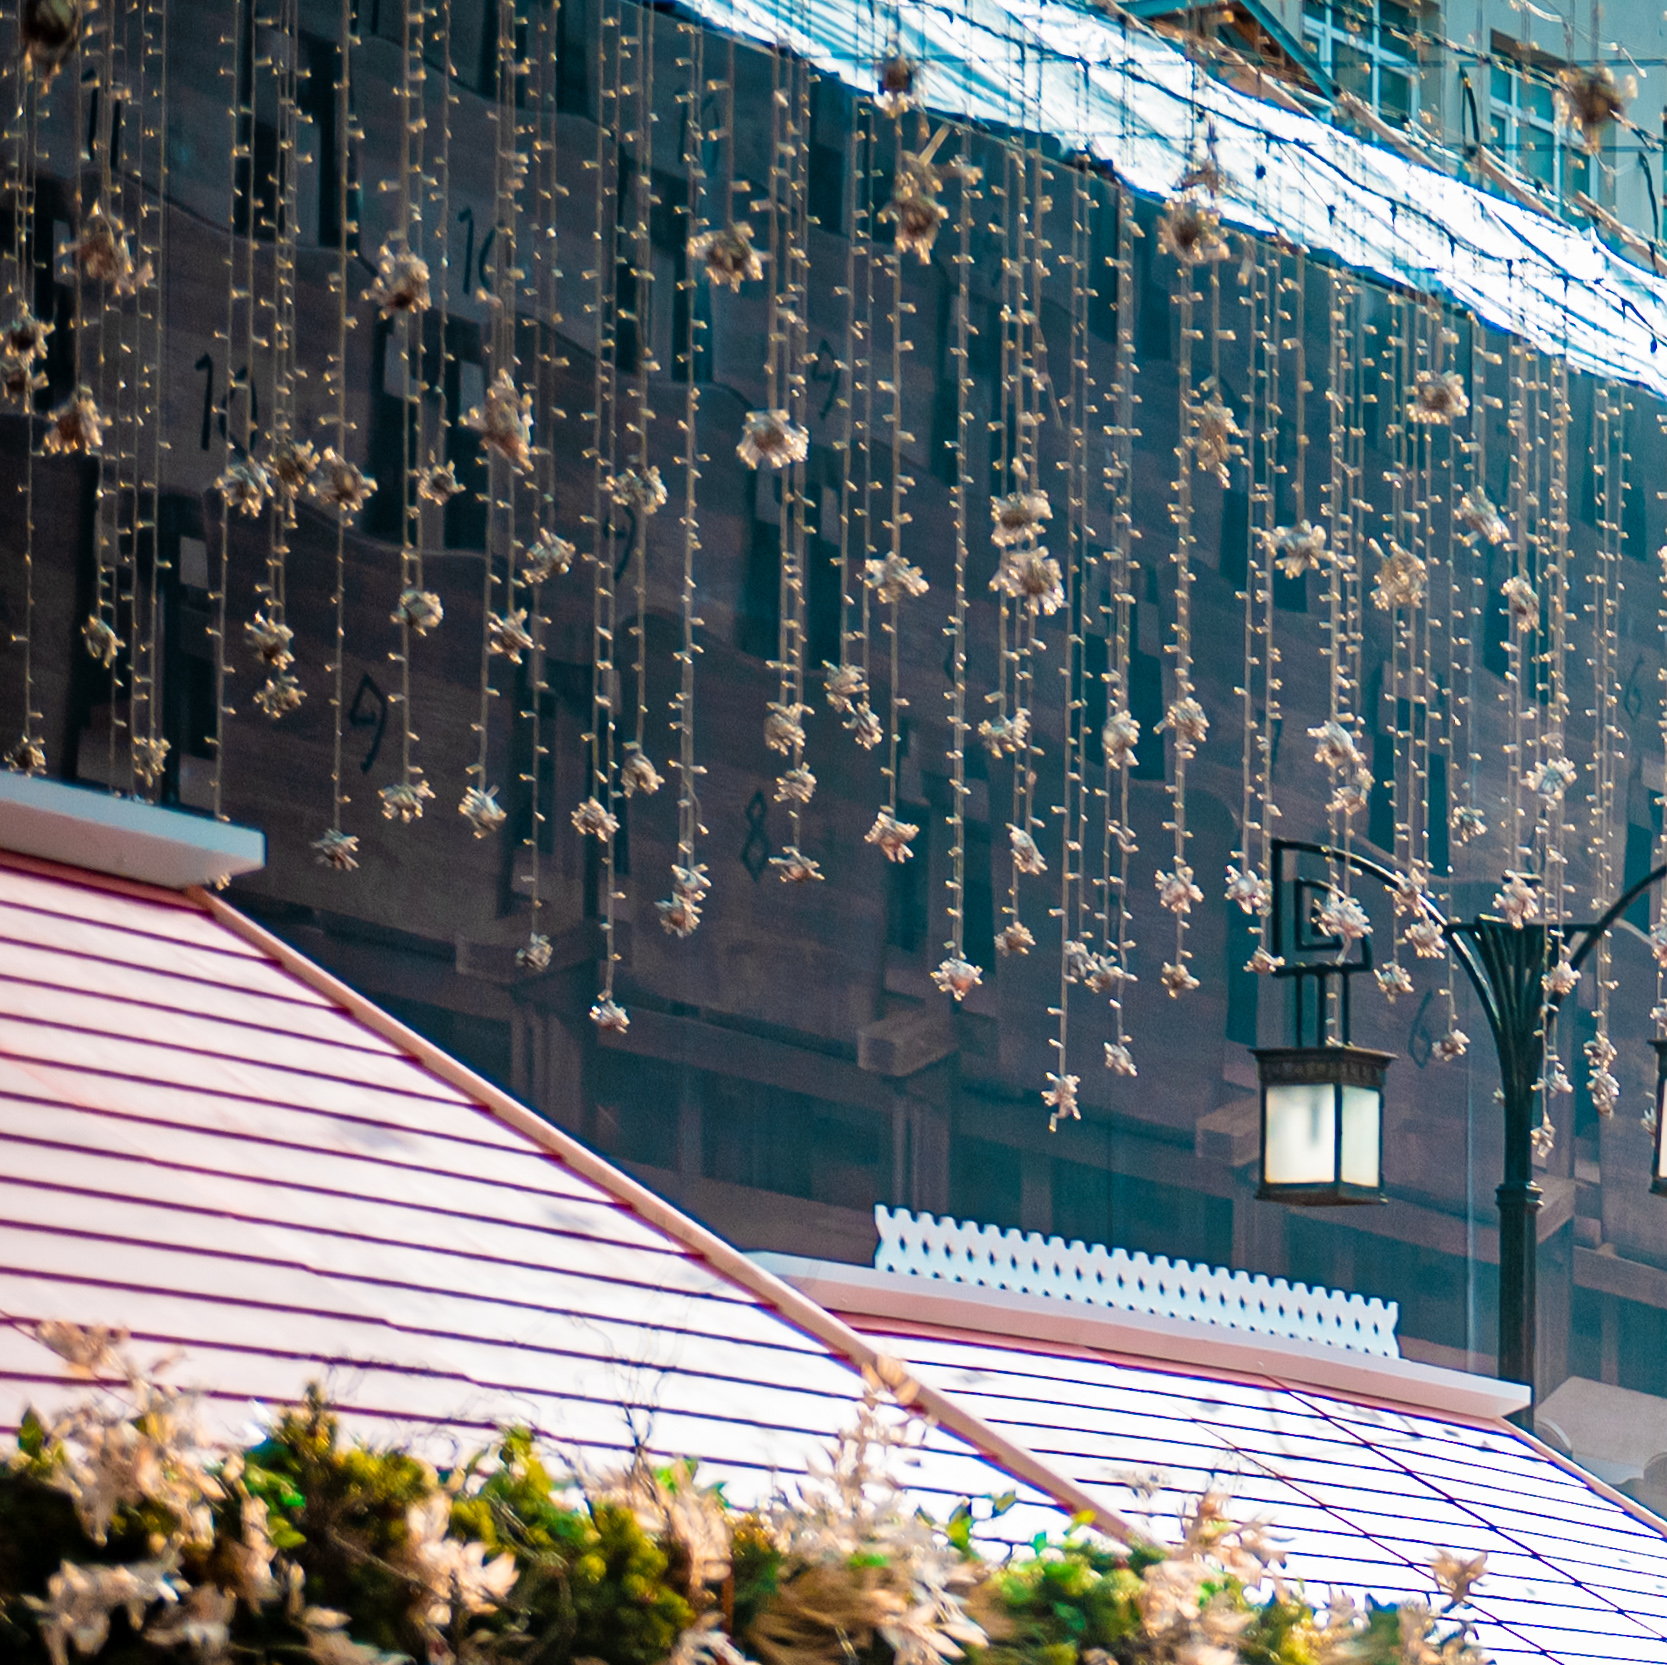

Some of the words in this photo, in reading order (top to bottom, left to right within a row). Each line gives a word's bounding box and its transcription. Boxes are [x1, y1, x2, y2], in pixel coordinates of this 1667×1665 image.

[195, 353, 255, 462] 10
[810, 338, 840, 420] 9
[347, 674, 386, 775] 9
[1624, 654, 1642, 722] 6
[740, 789, 770, 883] 8
[1408, 989, 1432, 1068] 6
